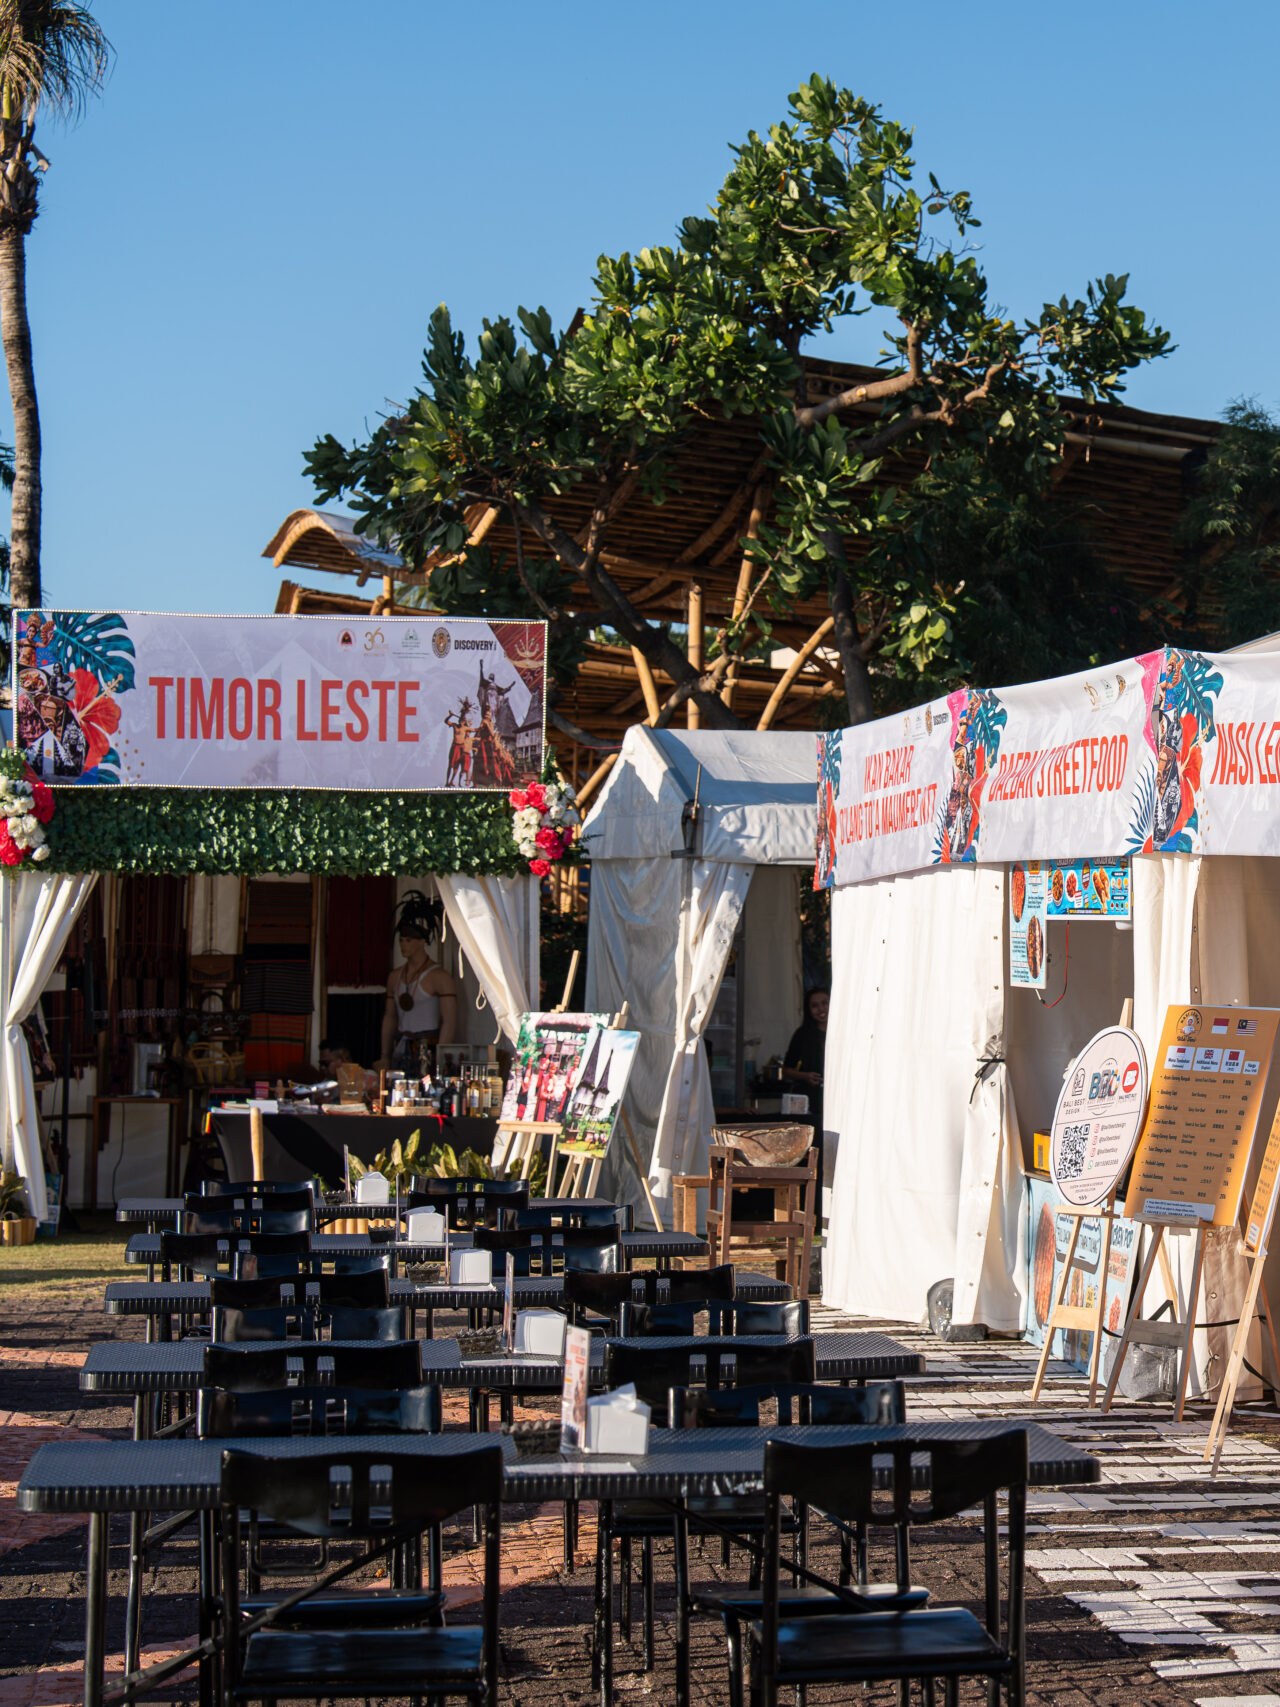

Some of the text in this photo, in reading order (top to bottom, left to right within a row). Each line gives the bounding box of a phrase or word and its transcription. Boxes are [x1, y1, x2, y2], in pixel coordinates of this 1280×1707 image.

[454, 639, 493, 651] DISCOVERY
[149, 676, 420, 742] TIMOR LESTE
[864, 745, 914, 794] IKAN BAKAR
[1210, 721, 1255, 785] NASI
[881, 788, 921, 835] MAUMERE
[1074, 1098, 1085, 1107] BEST
